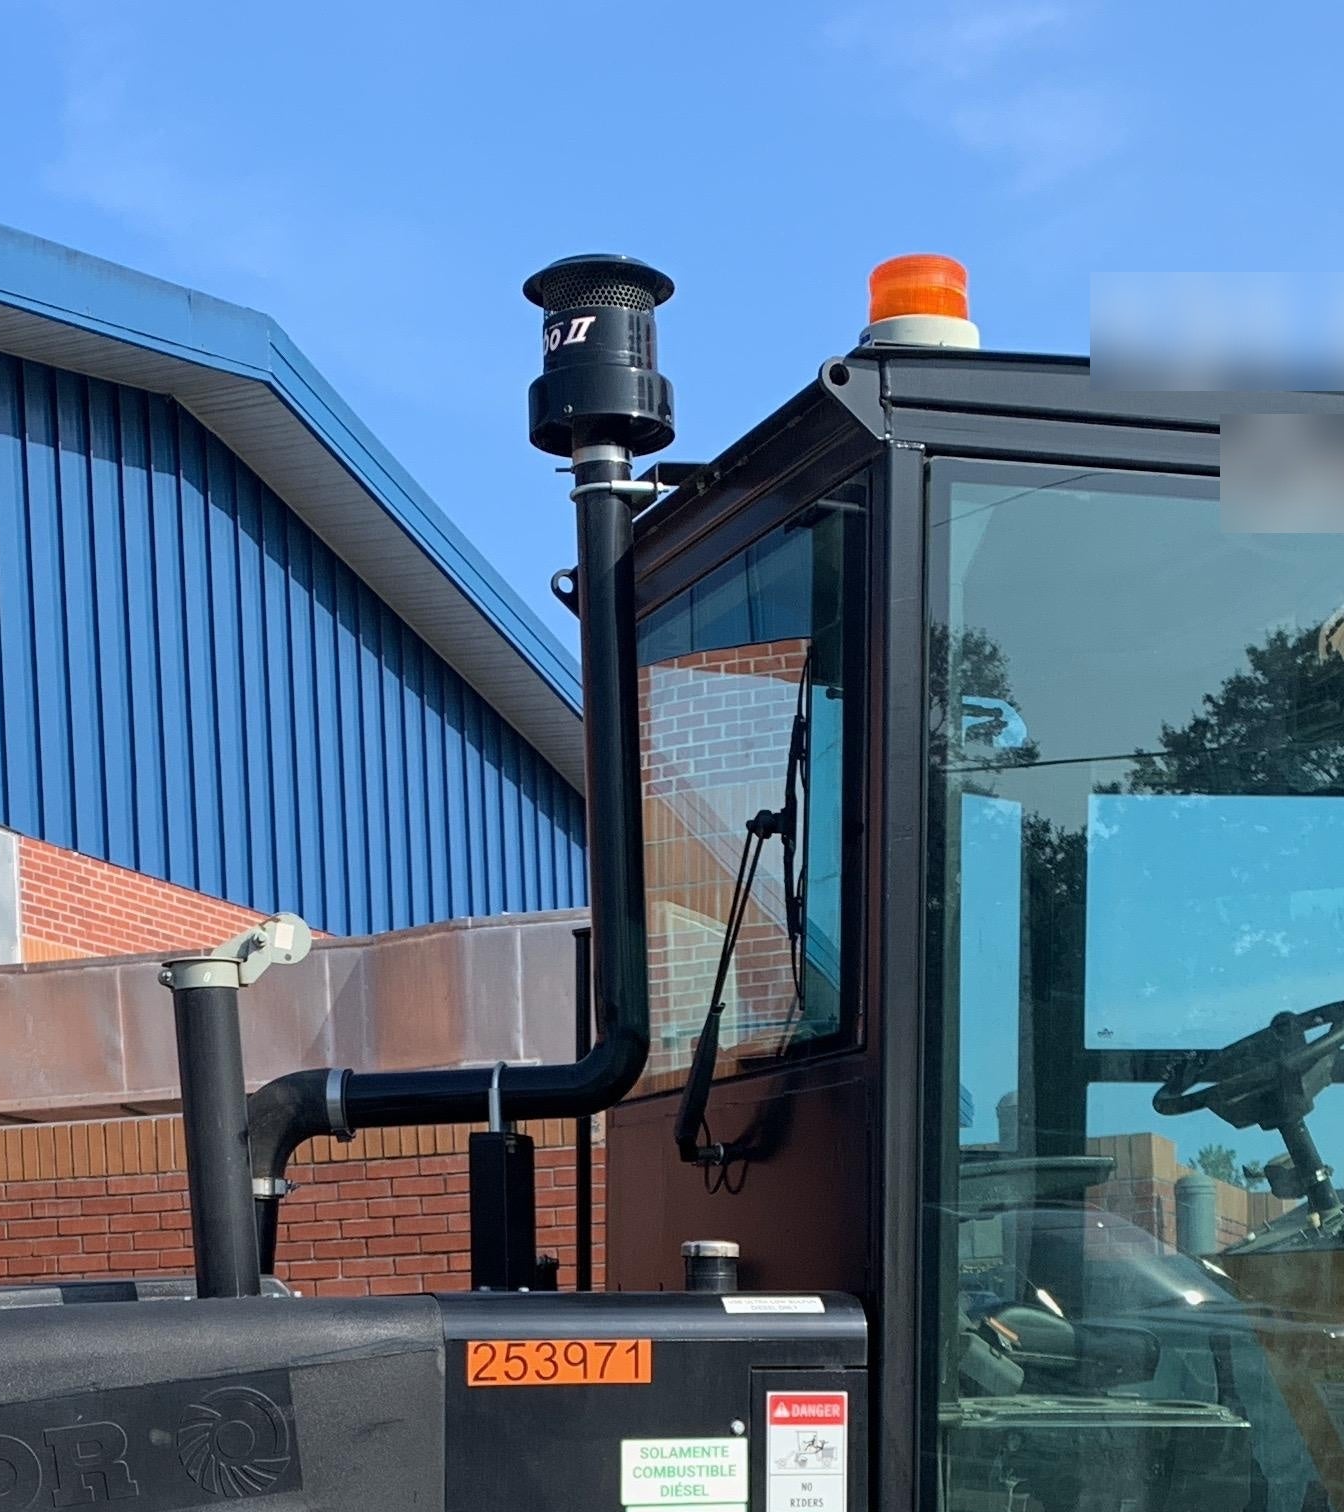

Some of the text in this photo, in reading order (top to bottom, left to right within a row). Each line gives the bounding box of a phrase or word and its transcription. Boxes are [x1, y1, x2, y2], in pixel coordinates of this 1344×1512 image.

[471, 1341, 641, 1382] 253971
[791, 1403, 841, 1418] DANGER
[639, 1446, 729, 1460] SOLAMENTE
[632, 1464, 737, 1479] COMBUSTIBLE
[659, 1481, 709, 1497] DIÉSEL
[801, 1482, 813, 1492] NO
[790, 1498, 824, 1508] RIDERS
